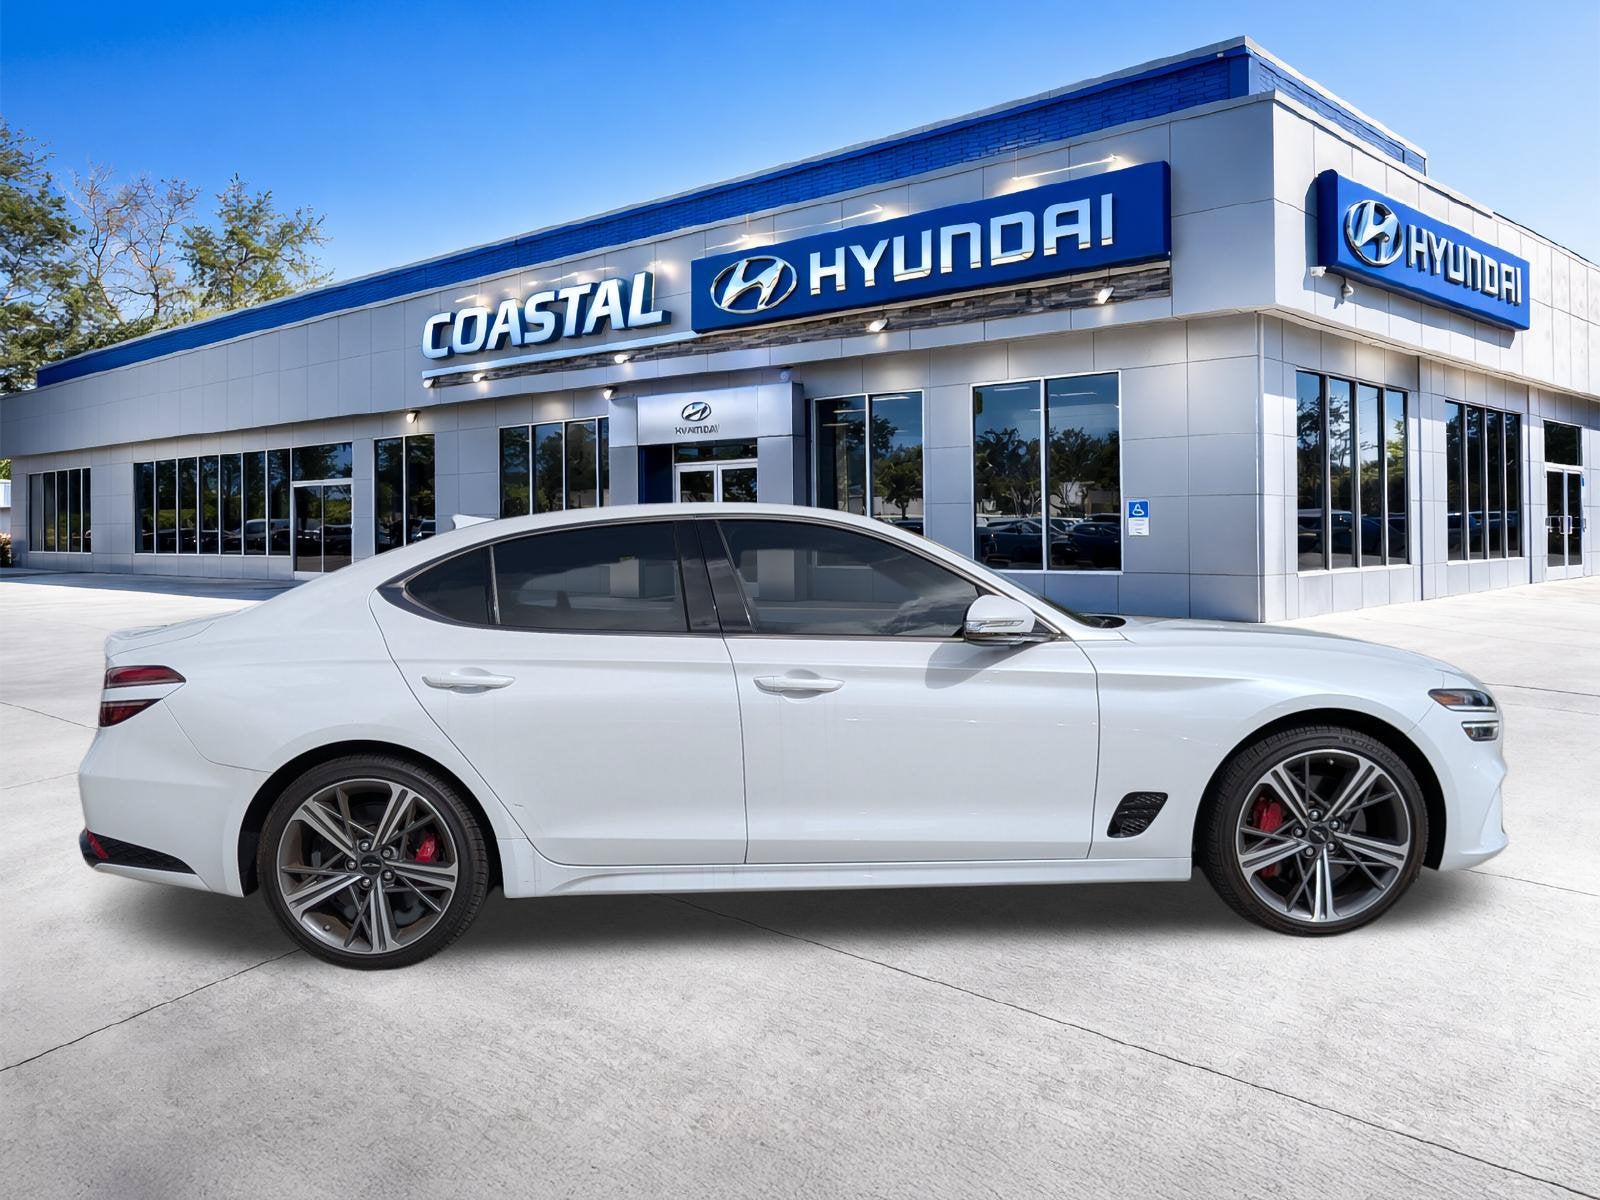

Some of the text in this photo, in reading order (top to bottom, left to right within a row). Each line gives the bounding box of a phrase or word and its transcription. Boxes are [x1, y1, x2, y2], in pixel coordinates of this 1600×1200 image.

[809, 192, 1114, 296] HYUNDAI
[1406, 223, 1523, 307] HYUNDAI
[422, 271, 671, 359] COASTAL
